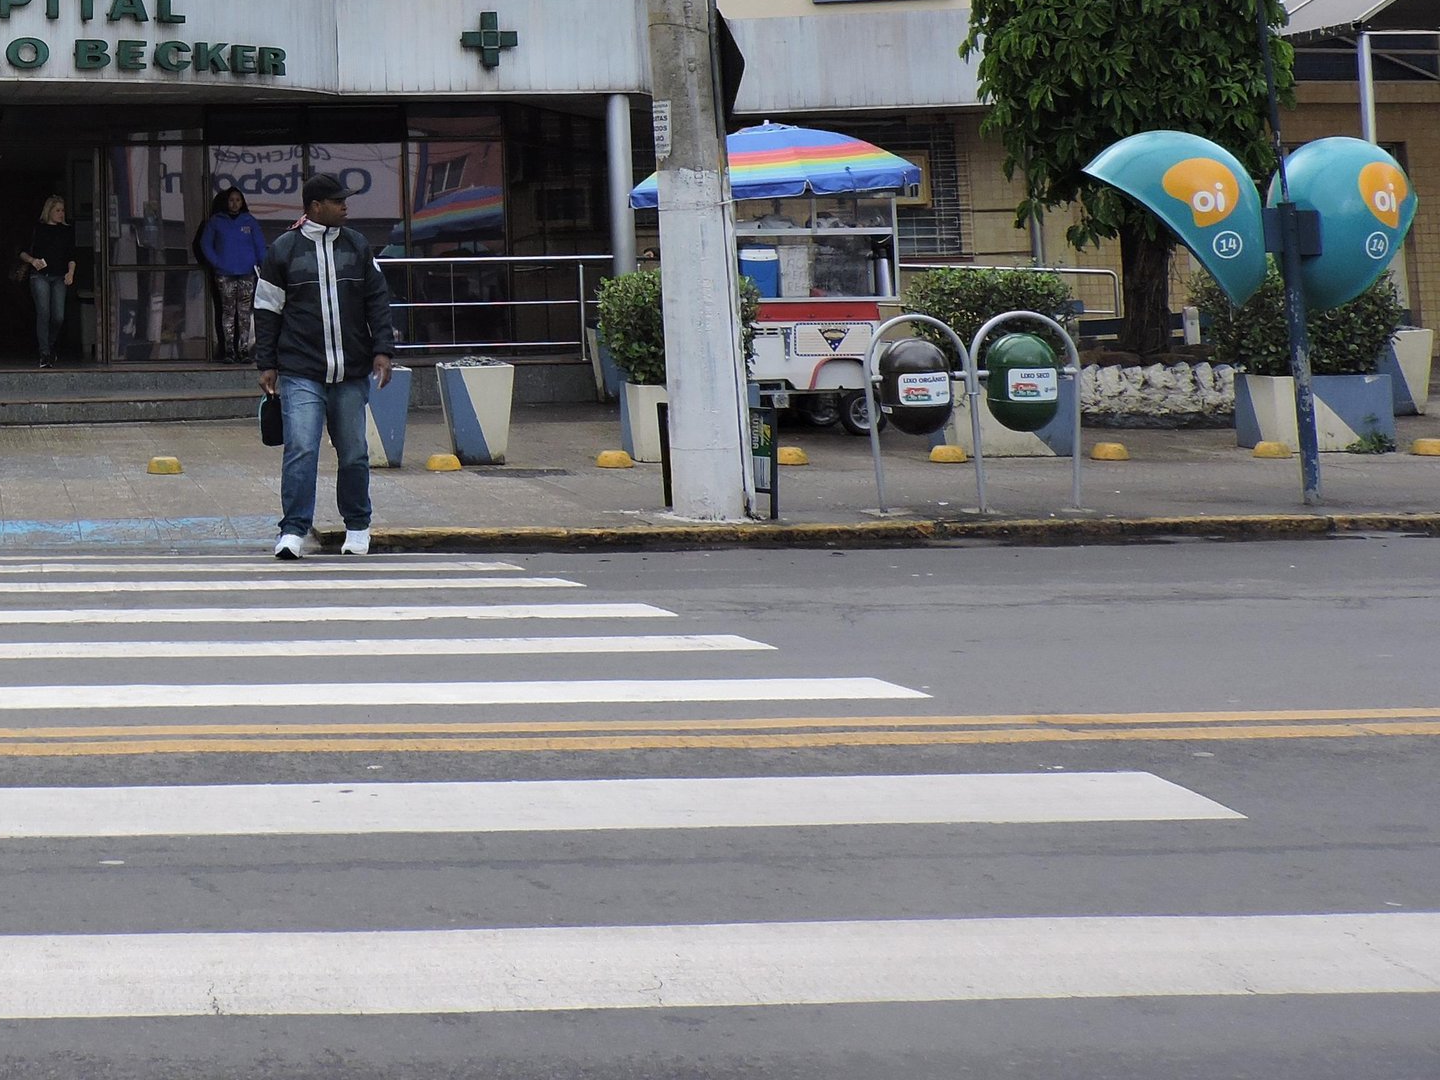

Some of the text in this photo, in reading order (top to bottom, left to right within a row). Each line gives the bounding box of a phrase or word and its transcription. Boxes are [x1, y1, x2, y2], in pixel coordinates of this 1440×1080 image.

[74, 38, 287, 76] BECKER
[1192, 182, 1226, 213] oi
[1374, 182, 1397, 213] oi
[1219, 237, 1238, 253] 14
[1370, 238, 1385, 253] 14
